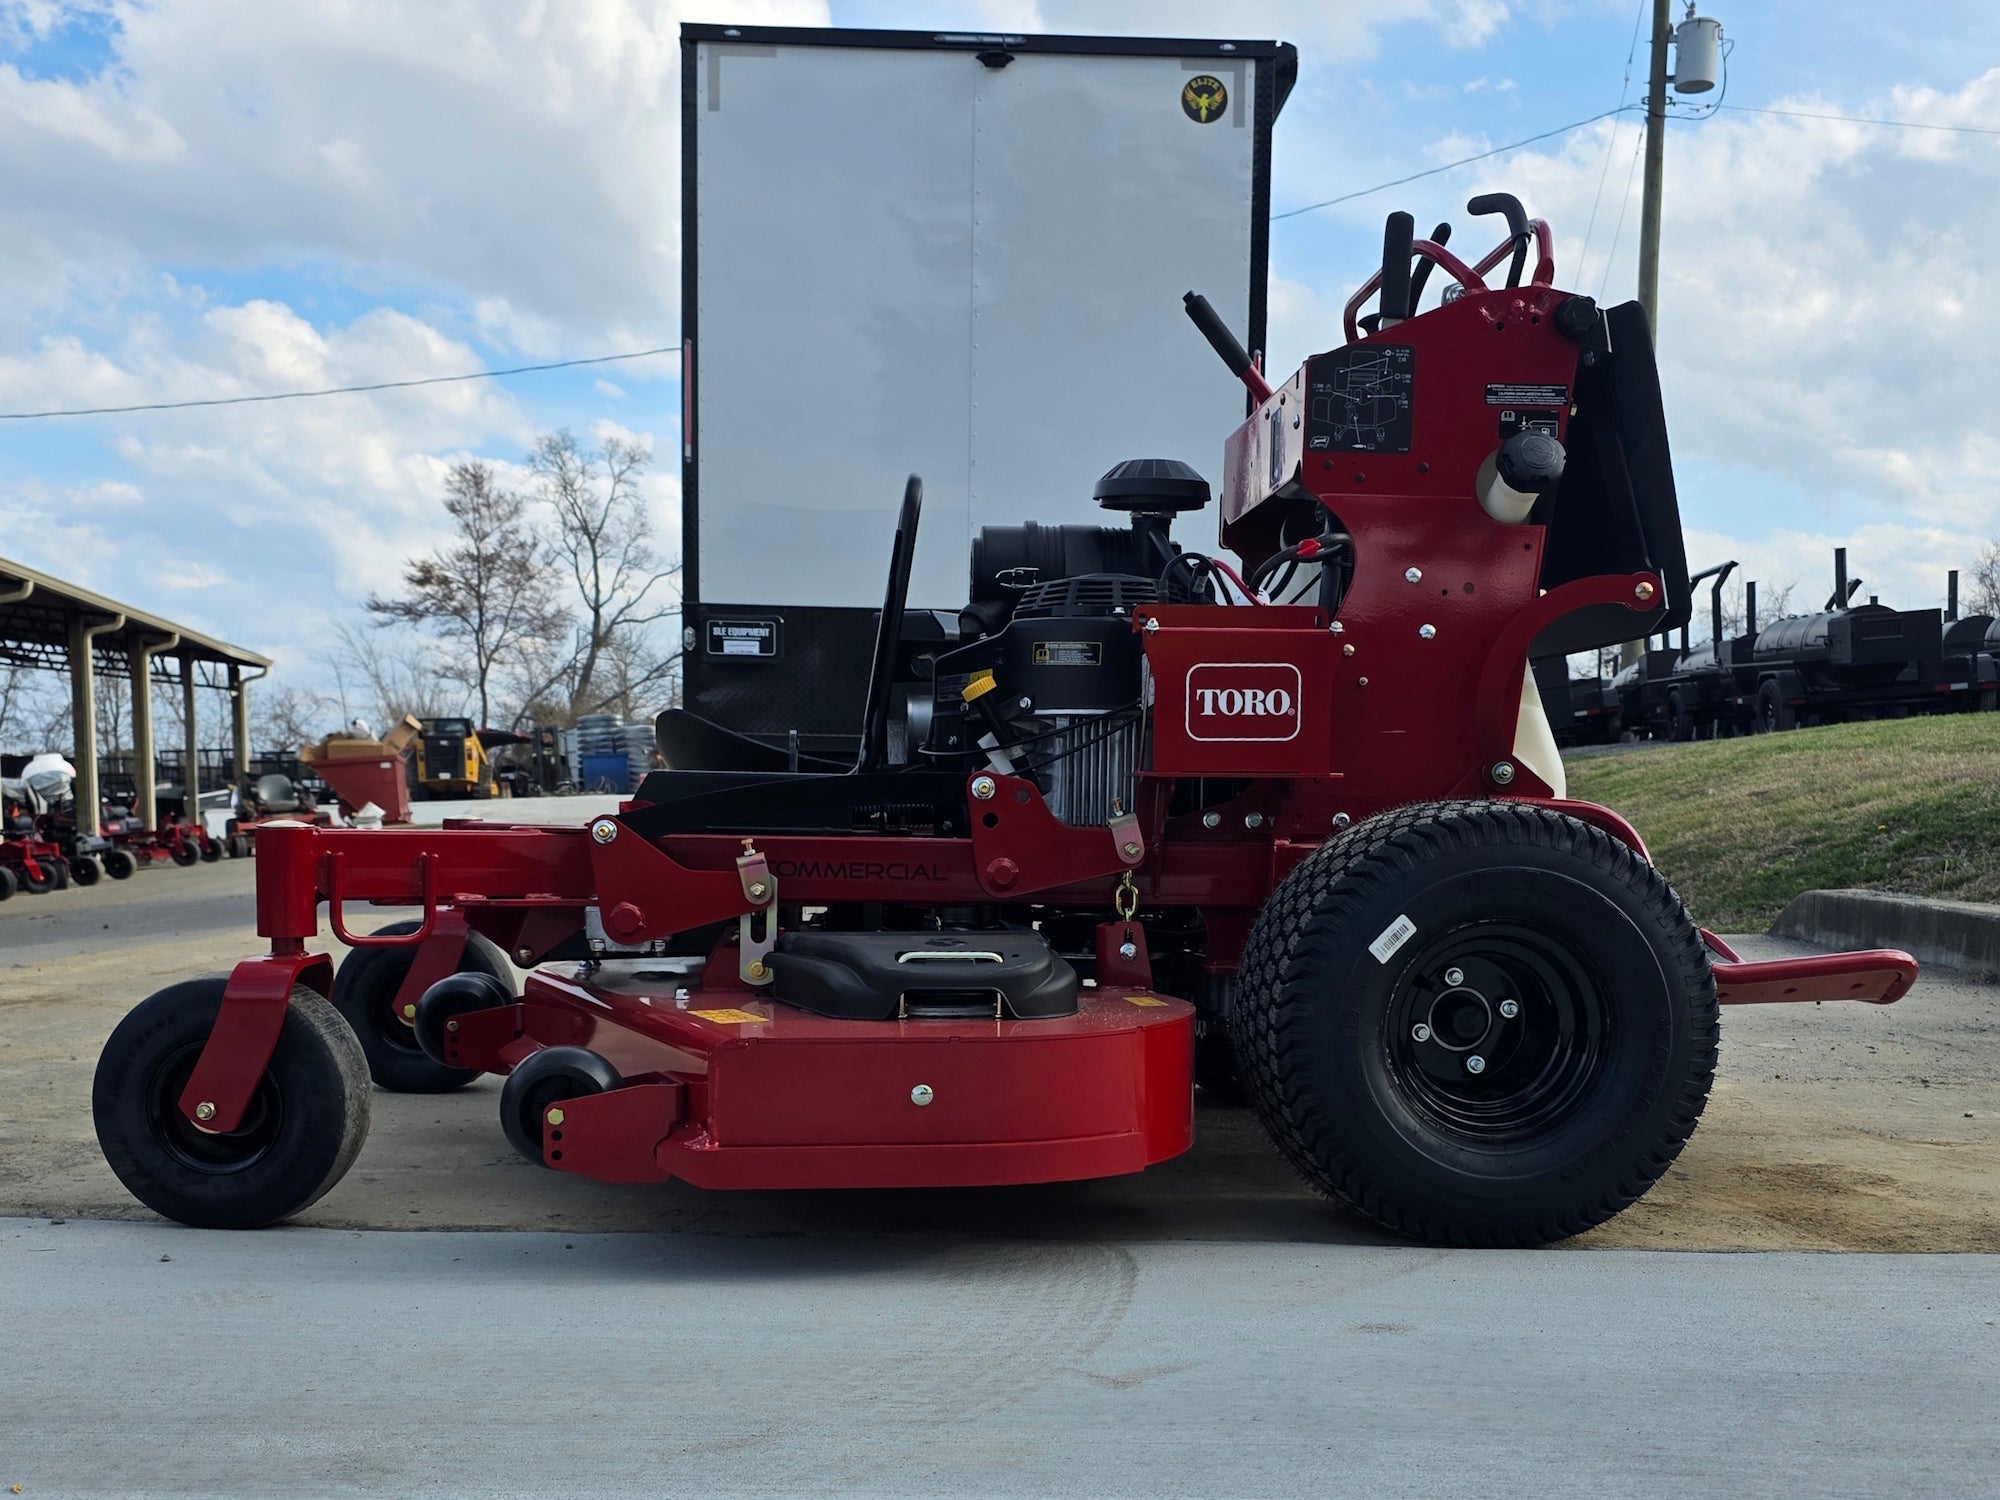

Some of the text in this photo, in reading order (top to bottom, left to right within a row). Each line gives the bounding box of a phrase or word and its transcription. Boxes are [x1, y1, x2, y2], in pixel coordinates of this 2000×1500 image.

[1190, 77, 1220, 90] ELITE
[728, 627, 770, 637] EQUIPMENT
[1196, 689, 1291, 716] TORO
